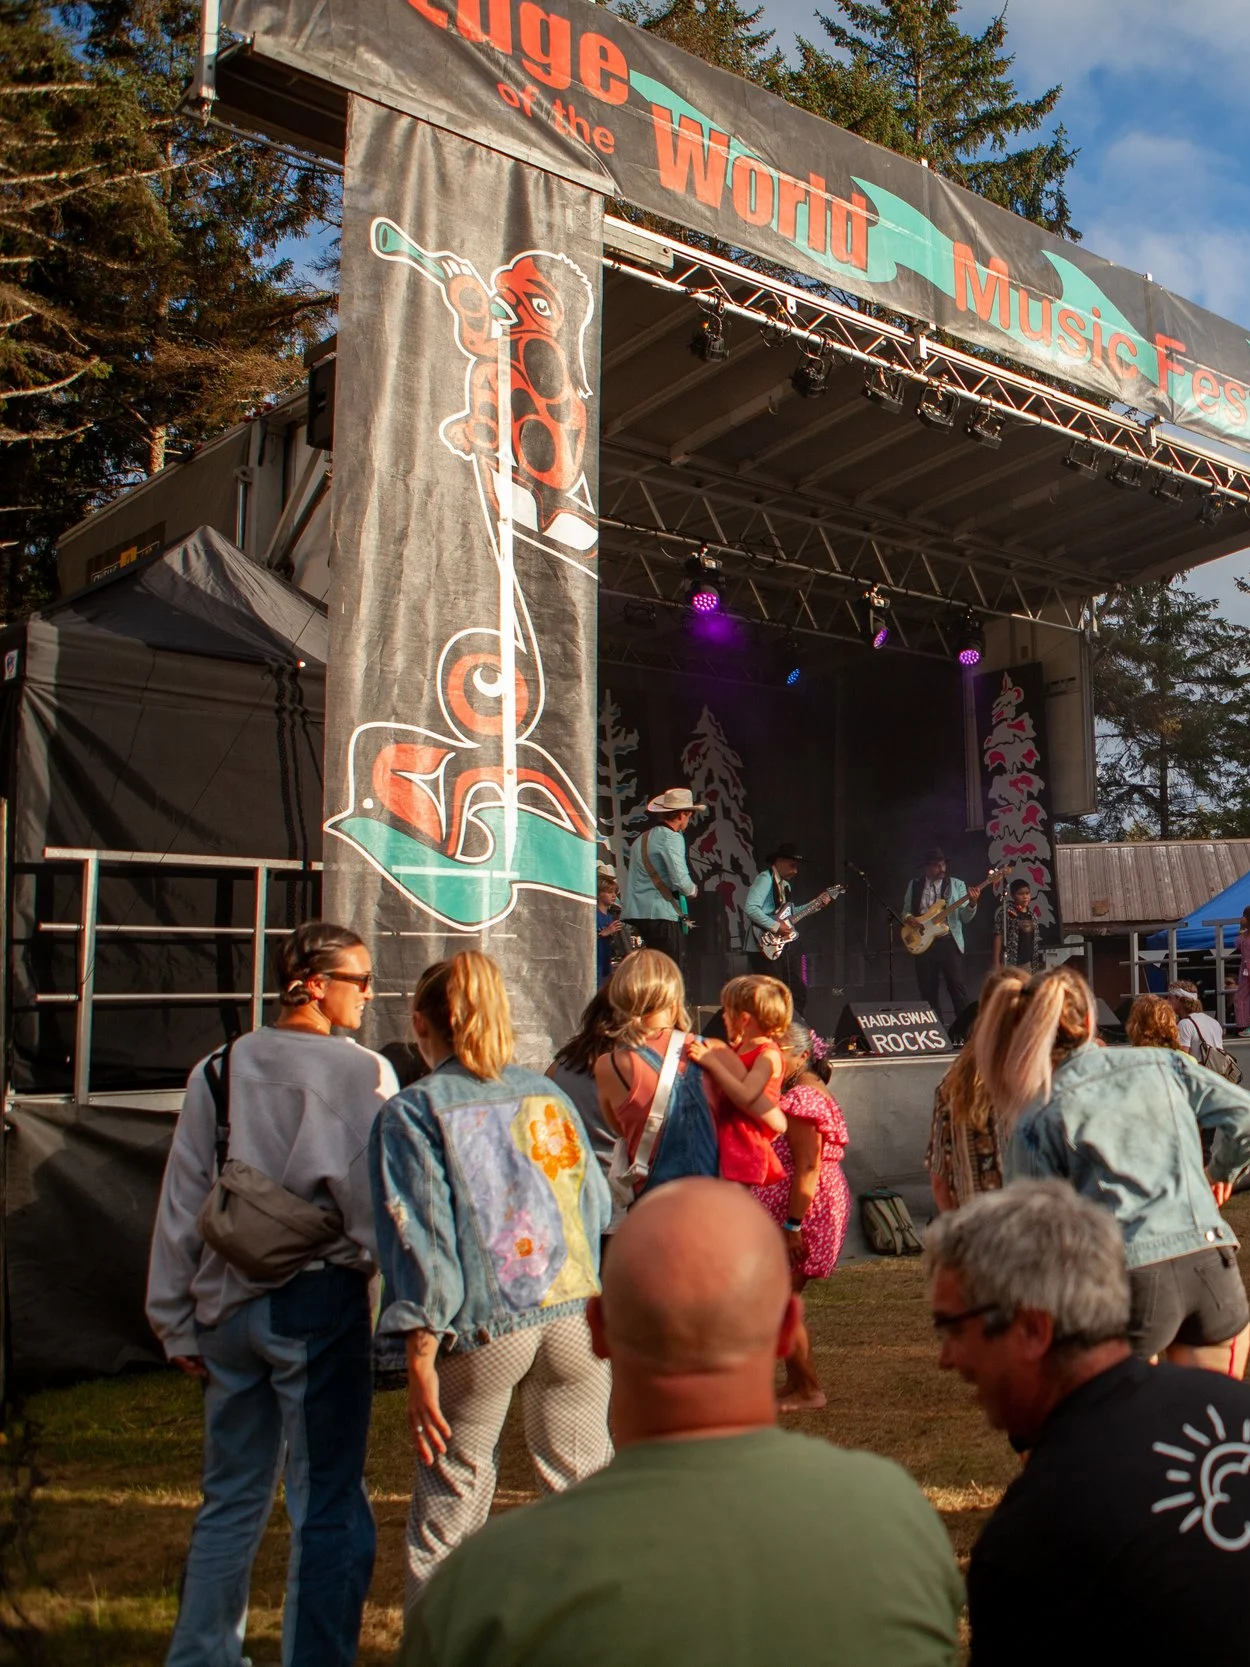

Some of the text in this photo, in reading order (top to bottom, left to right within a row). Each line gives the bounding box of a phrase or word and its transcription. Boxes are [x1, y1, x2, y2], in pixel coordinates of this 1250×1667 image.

[497, 82, 615, 155] of the
[651, 103, 868, 273] World
[952, 241, 1139, 380] Music
[857, 1010, 938, 1029] HAIDA GWAII
[872, 1029, 946, 1054] ROCKS
